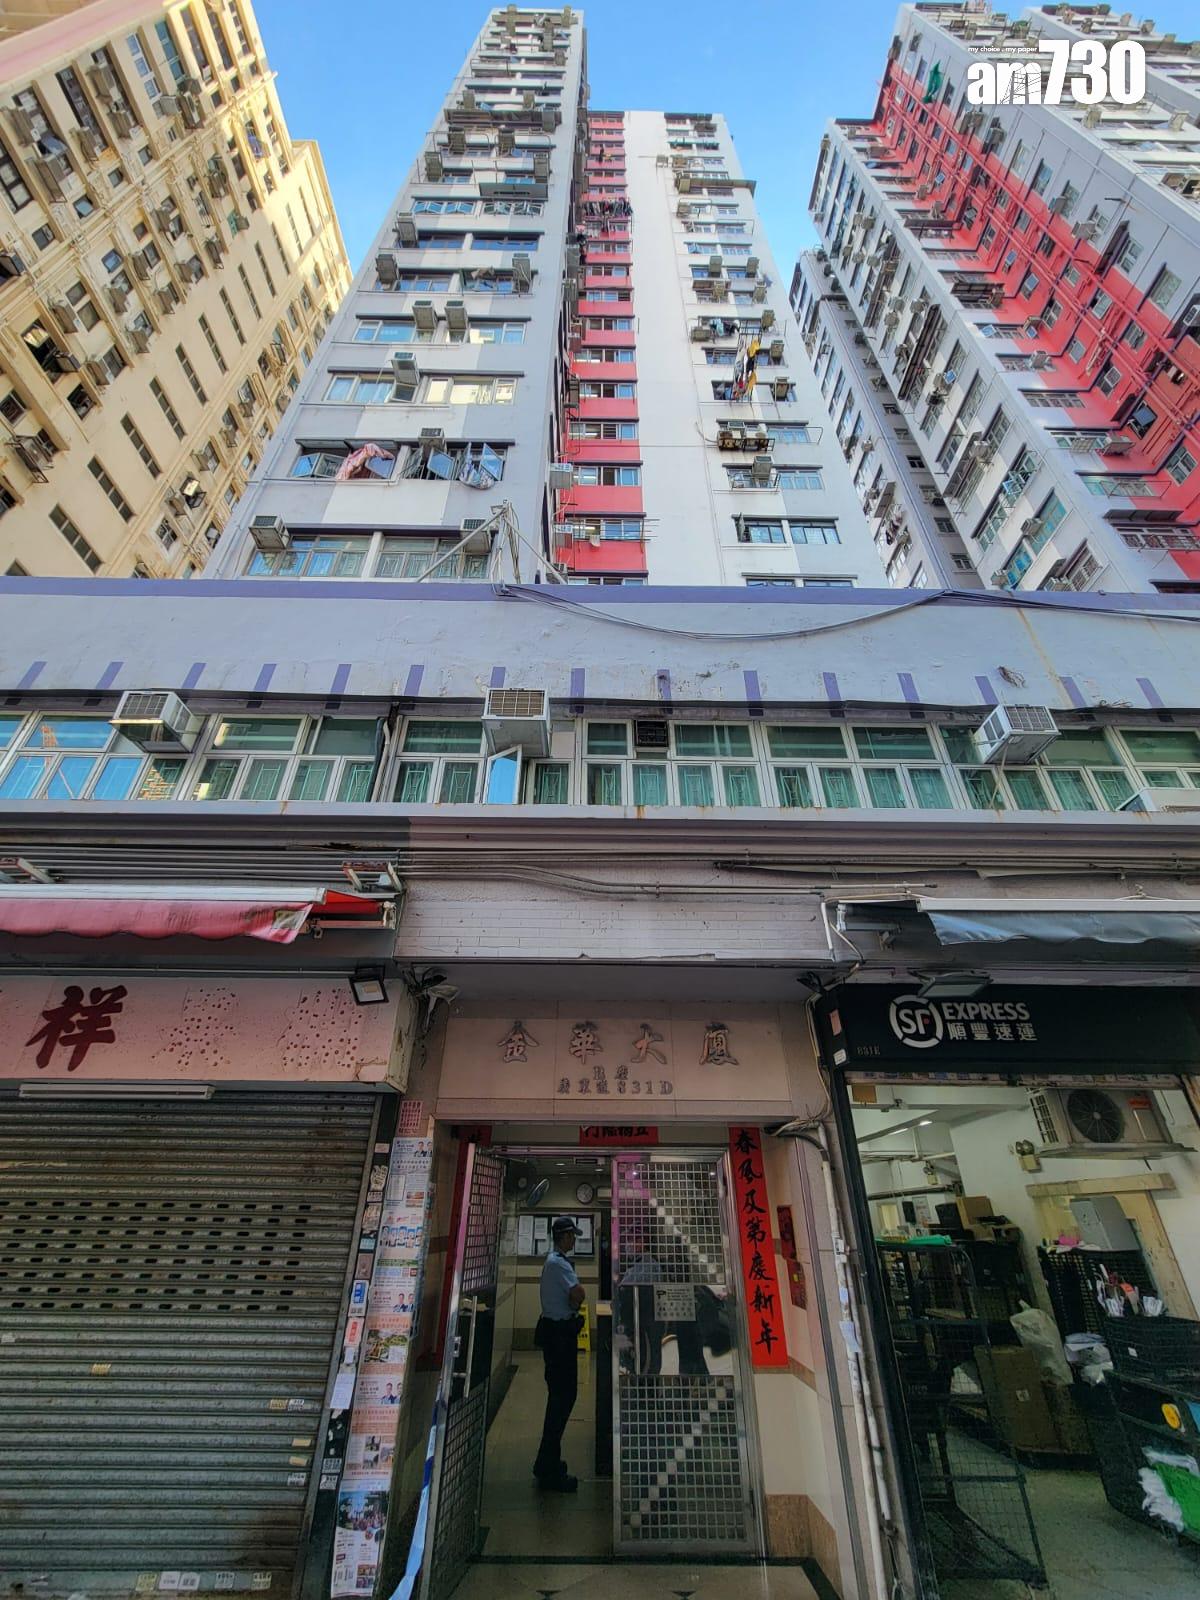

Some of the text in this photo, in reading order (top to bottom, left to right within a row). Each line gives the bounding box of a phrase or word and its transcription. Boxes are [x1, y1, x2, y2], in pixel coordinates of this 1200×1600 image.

[898, 1008, 930, 1035] SF
[941, 1002, 1031, 1021] EXPRESS
[25, 984, 128, 1072] 祥
[947, 1022, 1038, 1041] 順豐速運
[498, 1020, 739, 1066] 金華大廈
